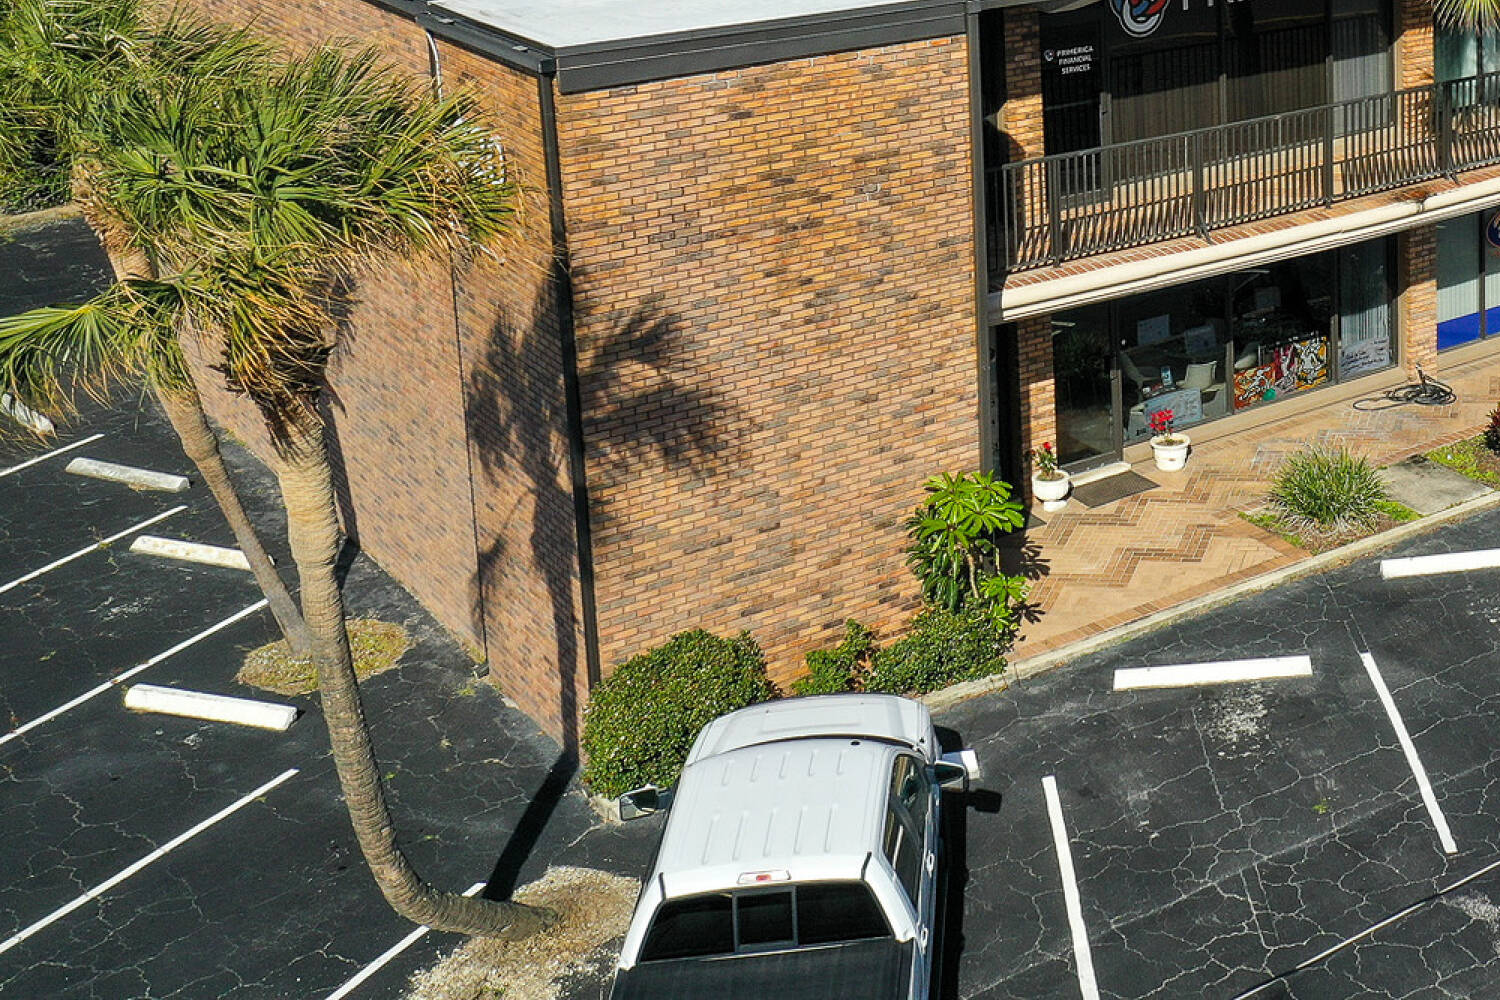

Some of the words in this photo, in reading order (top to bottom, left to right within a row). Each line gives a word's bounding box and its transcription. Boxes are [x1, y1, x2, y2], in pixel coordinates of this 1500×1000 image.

[1056, 45, 1094, 57] PRIMERICA
[1058, 54, 1092, 66] FINANCIAL
[1061, 64, 1091, 75] SERVICES
